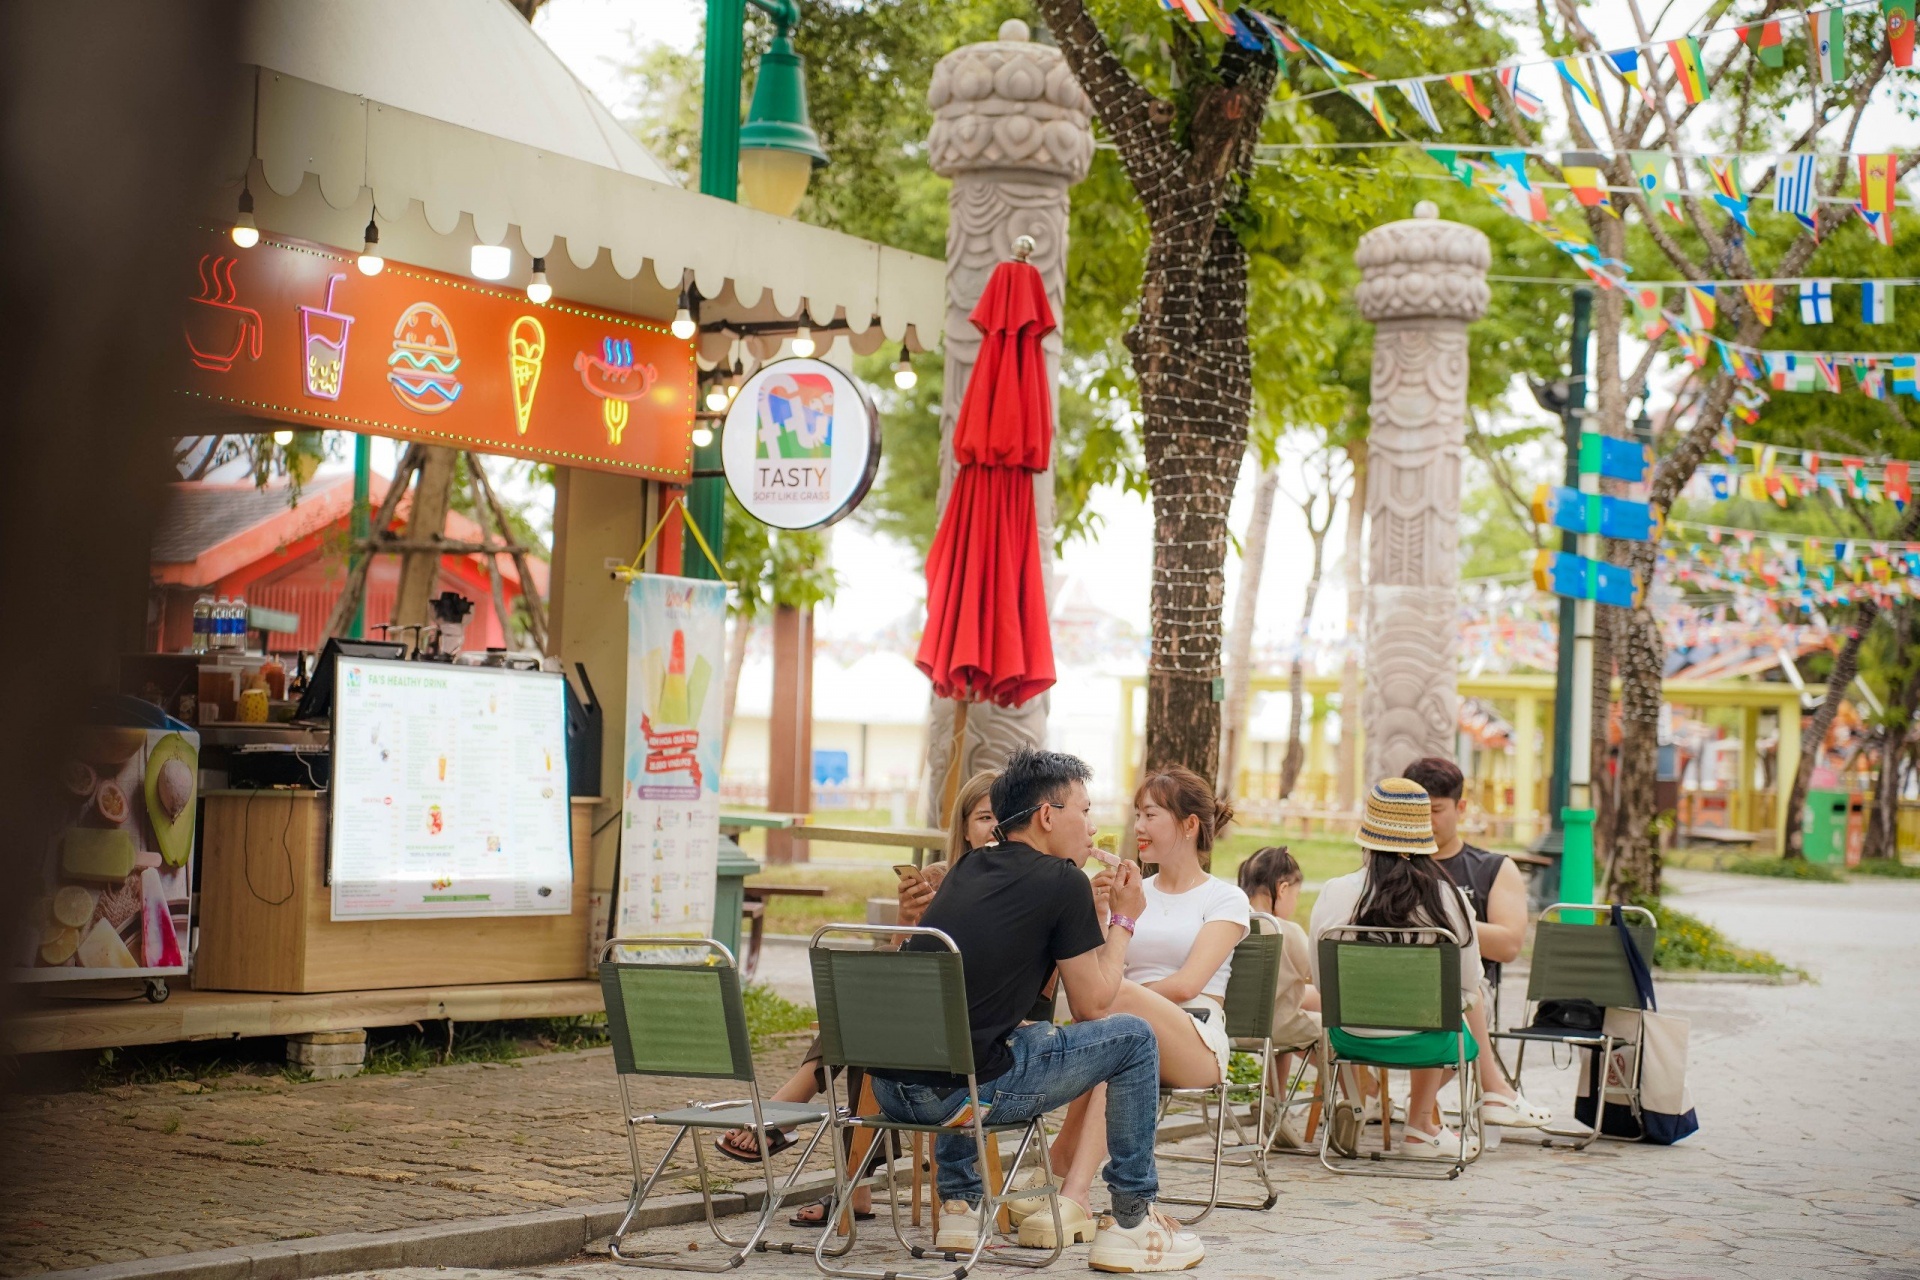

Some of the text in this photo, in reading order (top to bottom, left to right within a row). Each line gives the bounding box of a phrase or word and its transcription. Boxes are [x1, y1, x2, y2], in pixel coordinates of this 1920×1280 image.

[759, 468, 826, 487] TASTY
[753, 491, 830, 500] SOFT LIKE GRASS
[368, 674, 447, 689] FA'S HEALTHY DRINK
